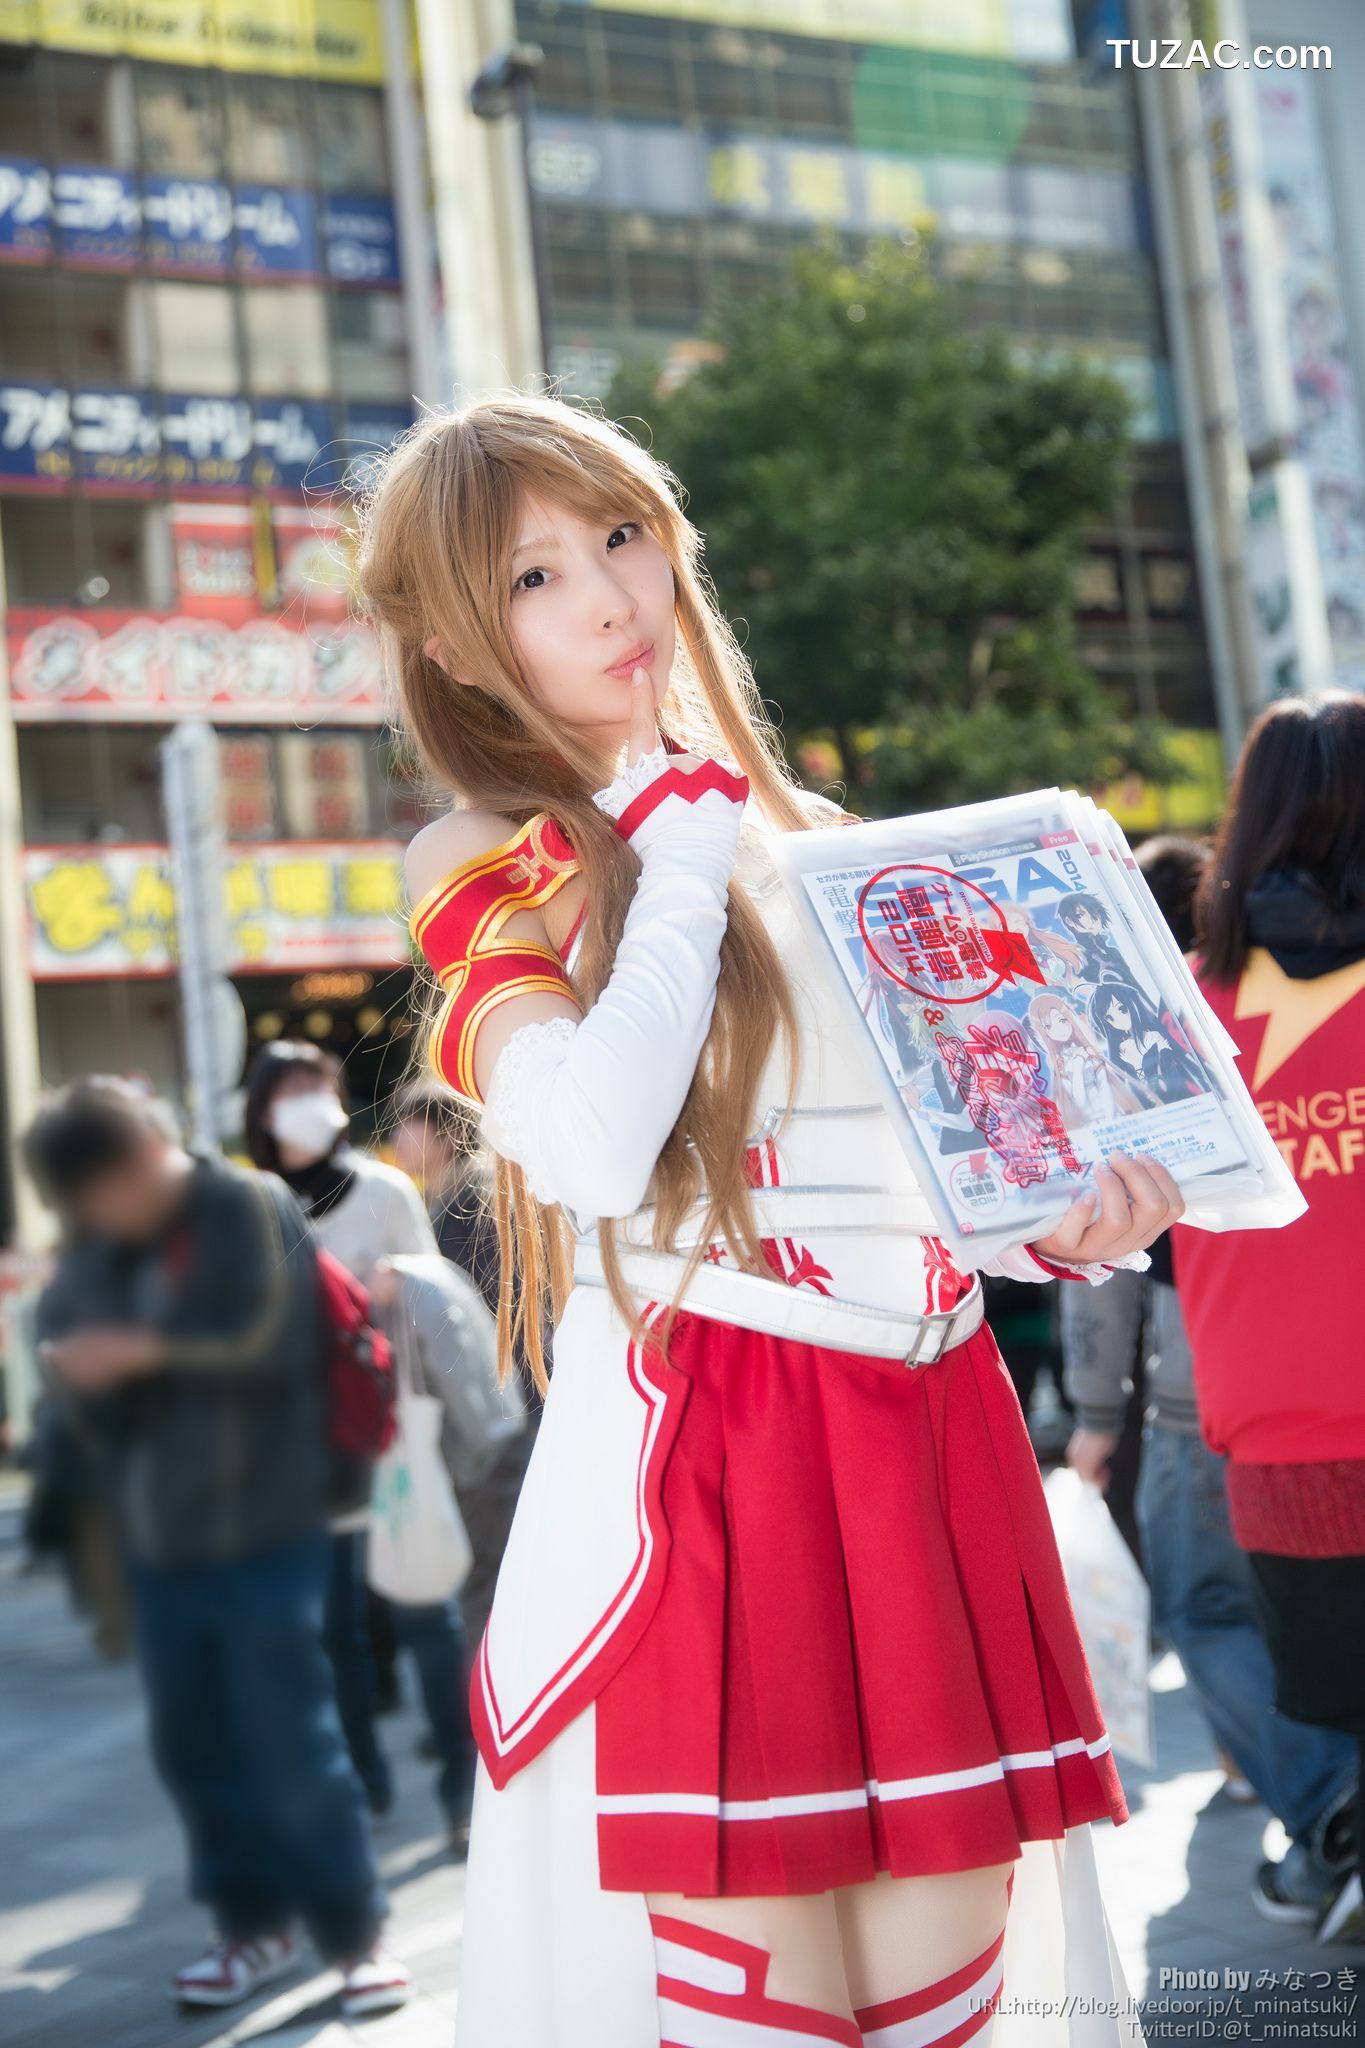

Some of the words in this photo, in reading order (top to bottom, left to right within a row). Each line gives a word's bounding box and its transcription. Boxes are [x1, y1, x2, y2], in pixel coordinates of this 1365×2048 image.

[1049, 834, 1069, 844] Free
[1056, 848, 1088, 893] 2014
[822, 883, 863, 934] 電撃
[854, 856, 1074, 929] SEGA
[959, 890, 973, 918] DENGEKI
[969, 917, 980, 934] GAME
[976, 932, 994, 962] FESTIVAL
[877, 900, 925, 977] 2014
[896, 885, 964, 982] 感謝祭
[931, 881, 988, 981] ゲームの電撃
[923, 1008, 945, 1027] &
[935, 1031, 1001, 1132] 2014
